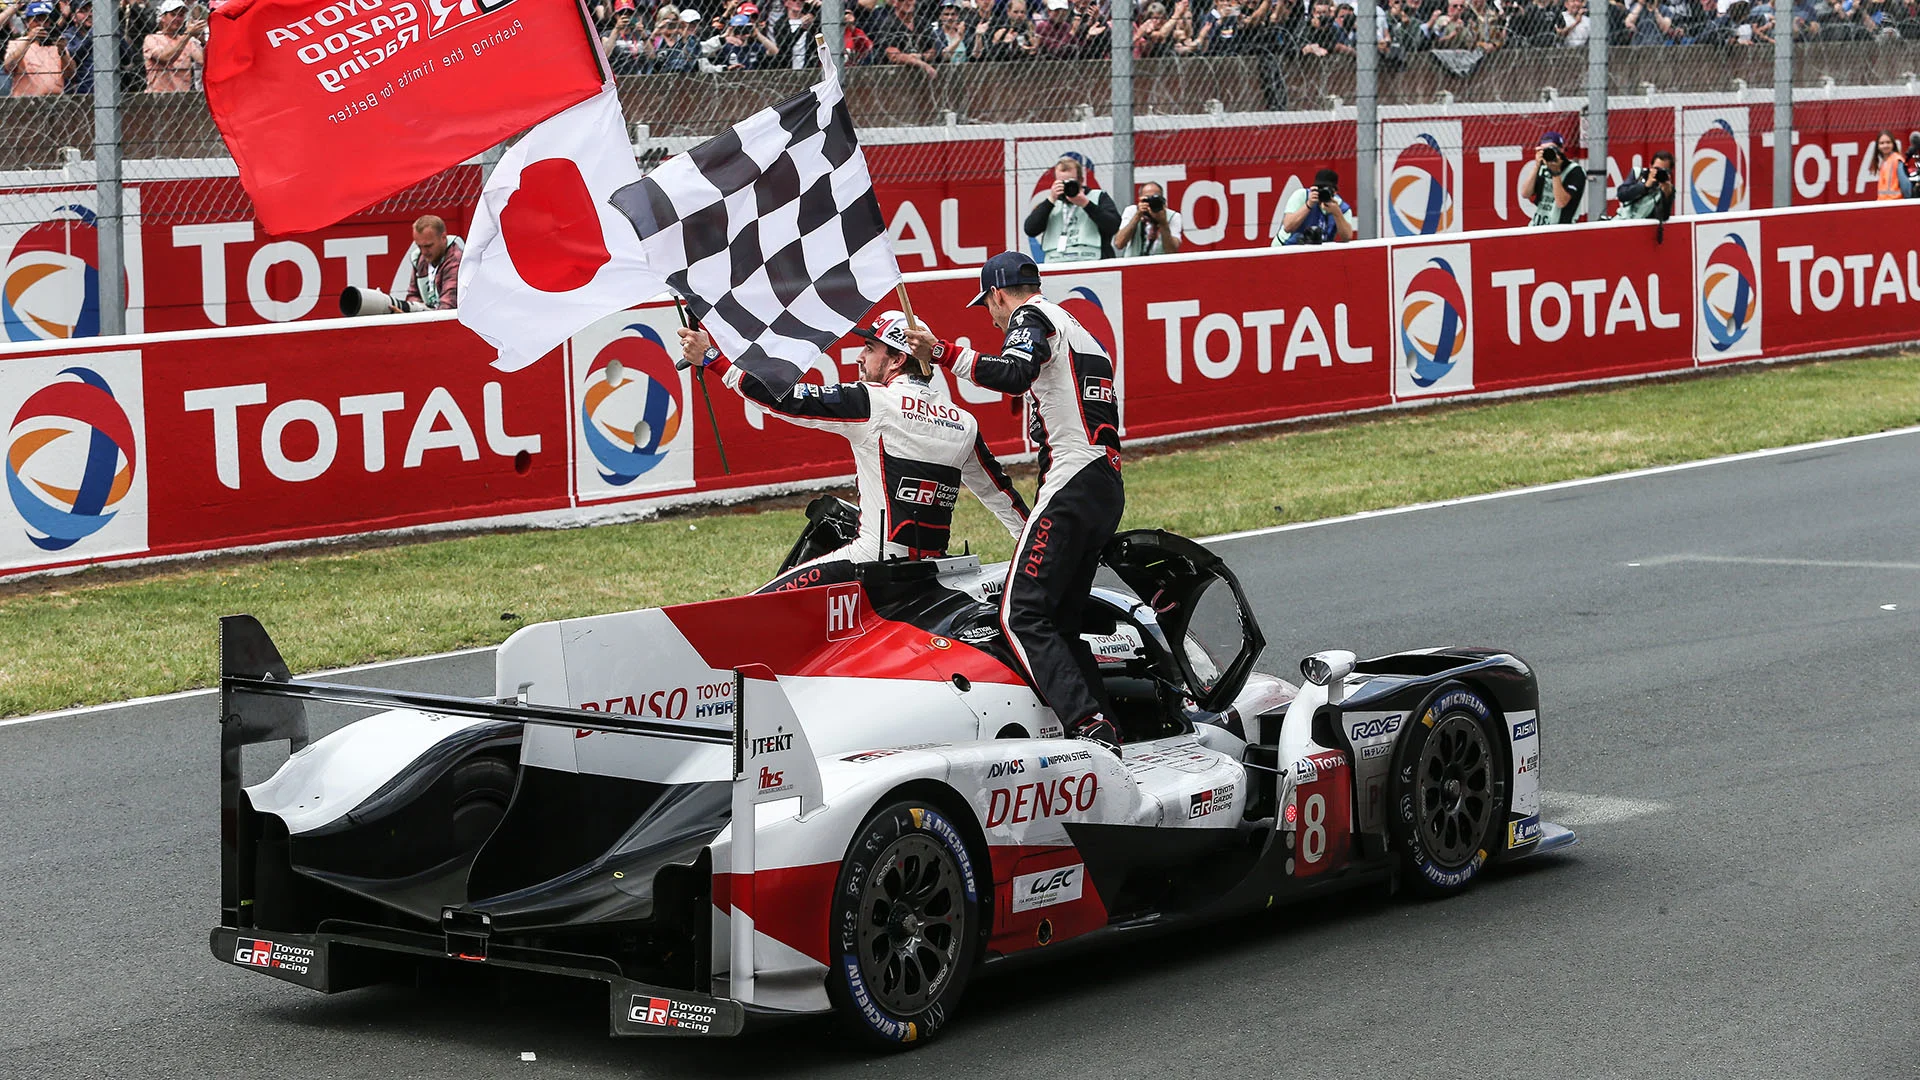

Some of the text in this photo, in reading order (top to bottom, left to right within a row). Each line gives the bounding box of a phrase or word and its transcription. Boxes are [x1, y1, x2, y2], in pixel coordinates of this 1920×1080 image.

[172, 221, 416, 326] TOT
[1777, 245, 1920, 316] TOTAL
[1491, 268, 1680, 345] TOTAL
[1147, 299, 1373, 384] TOTAL
[901, 396, 960, 422] DENSO
[903, 411, 933, 424] TOYOTA
[184, 381, 541, 490] TOTAL
[1025, 517, 1053, 578] DENSO
[776, 567, 822, 592] ENSO
[829, 593, 858, 632] HY
[1093, 633, 1136, 648] TOYOTA 8
[1100, 643, 1130, 655] HYBRID
[696, 682, 733, 700] TOYO
[695, 701, 733, 718] HYBR
[1441, 692, 1486, 716] MICHELIN
[1352, 714, 1402, 741] RAYS
[1516, 721, 1535, 737] AISIN
[751, 733, 793, 760] JTEKT
[1047, 750, 1093, 766] NIPPON STEEL
[1213, 784, 1235, 796] TOYOTA
[1213, 793, 1233, 804] GAZOO
[986, 772, 1098, 829] DENSO
[1190, 800, 1212, 819] GR
[1212, 801, 1232, 813] Racing
[1303, 793, 1327, 863] 8
[934, 818, 977, 894] MICHELIN
[1030, 868, 1076, 895] WEC
[1426, 861, 1473, 887] MICHELIN
[236, 948, 270, 966] GR
[272, 952, 310, 965] GAZOO
[274, 943, 315, 957] TOYOTA
[271, 960, 308, 974] Racing
[671, 1001, 717, 1015] TOYOTA
[847, 963, 897, 1037] MICHELIN
[630, 1005, 667, 1024] GR
[669, 1010, 712, 1023] GAZOO
[667, 1018, 710, 1034] Racing
